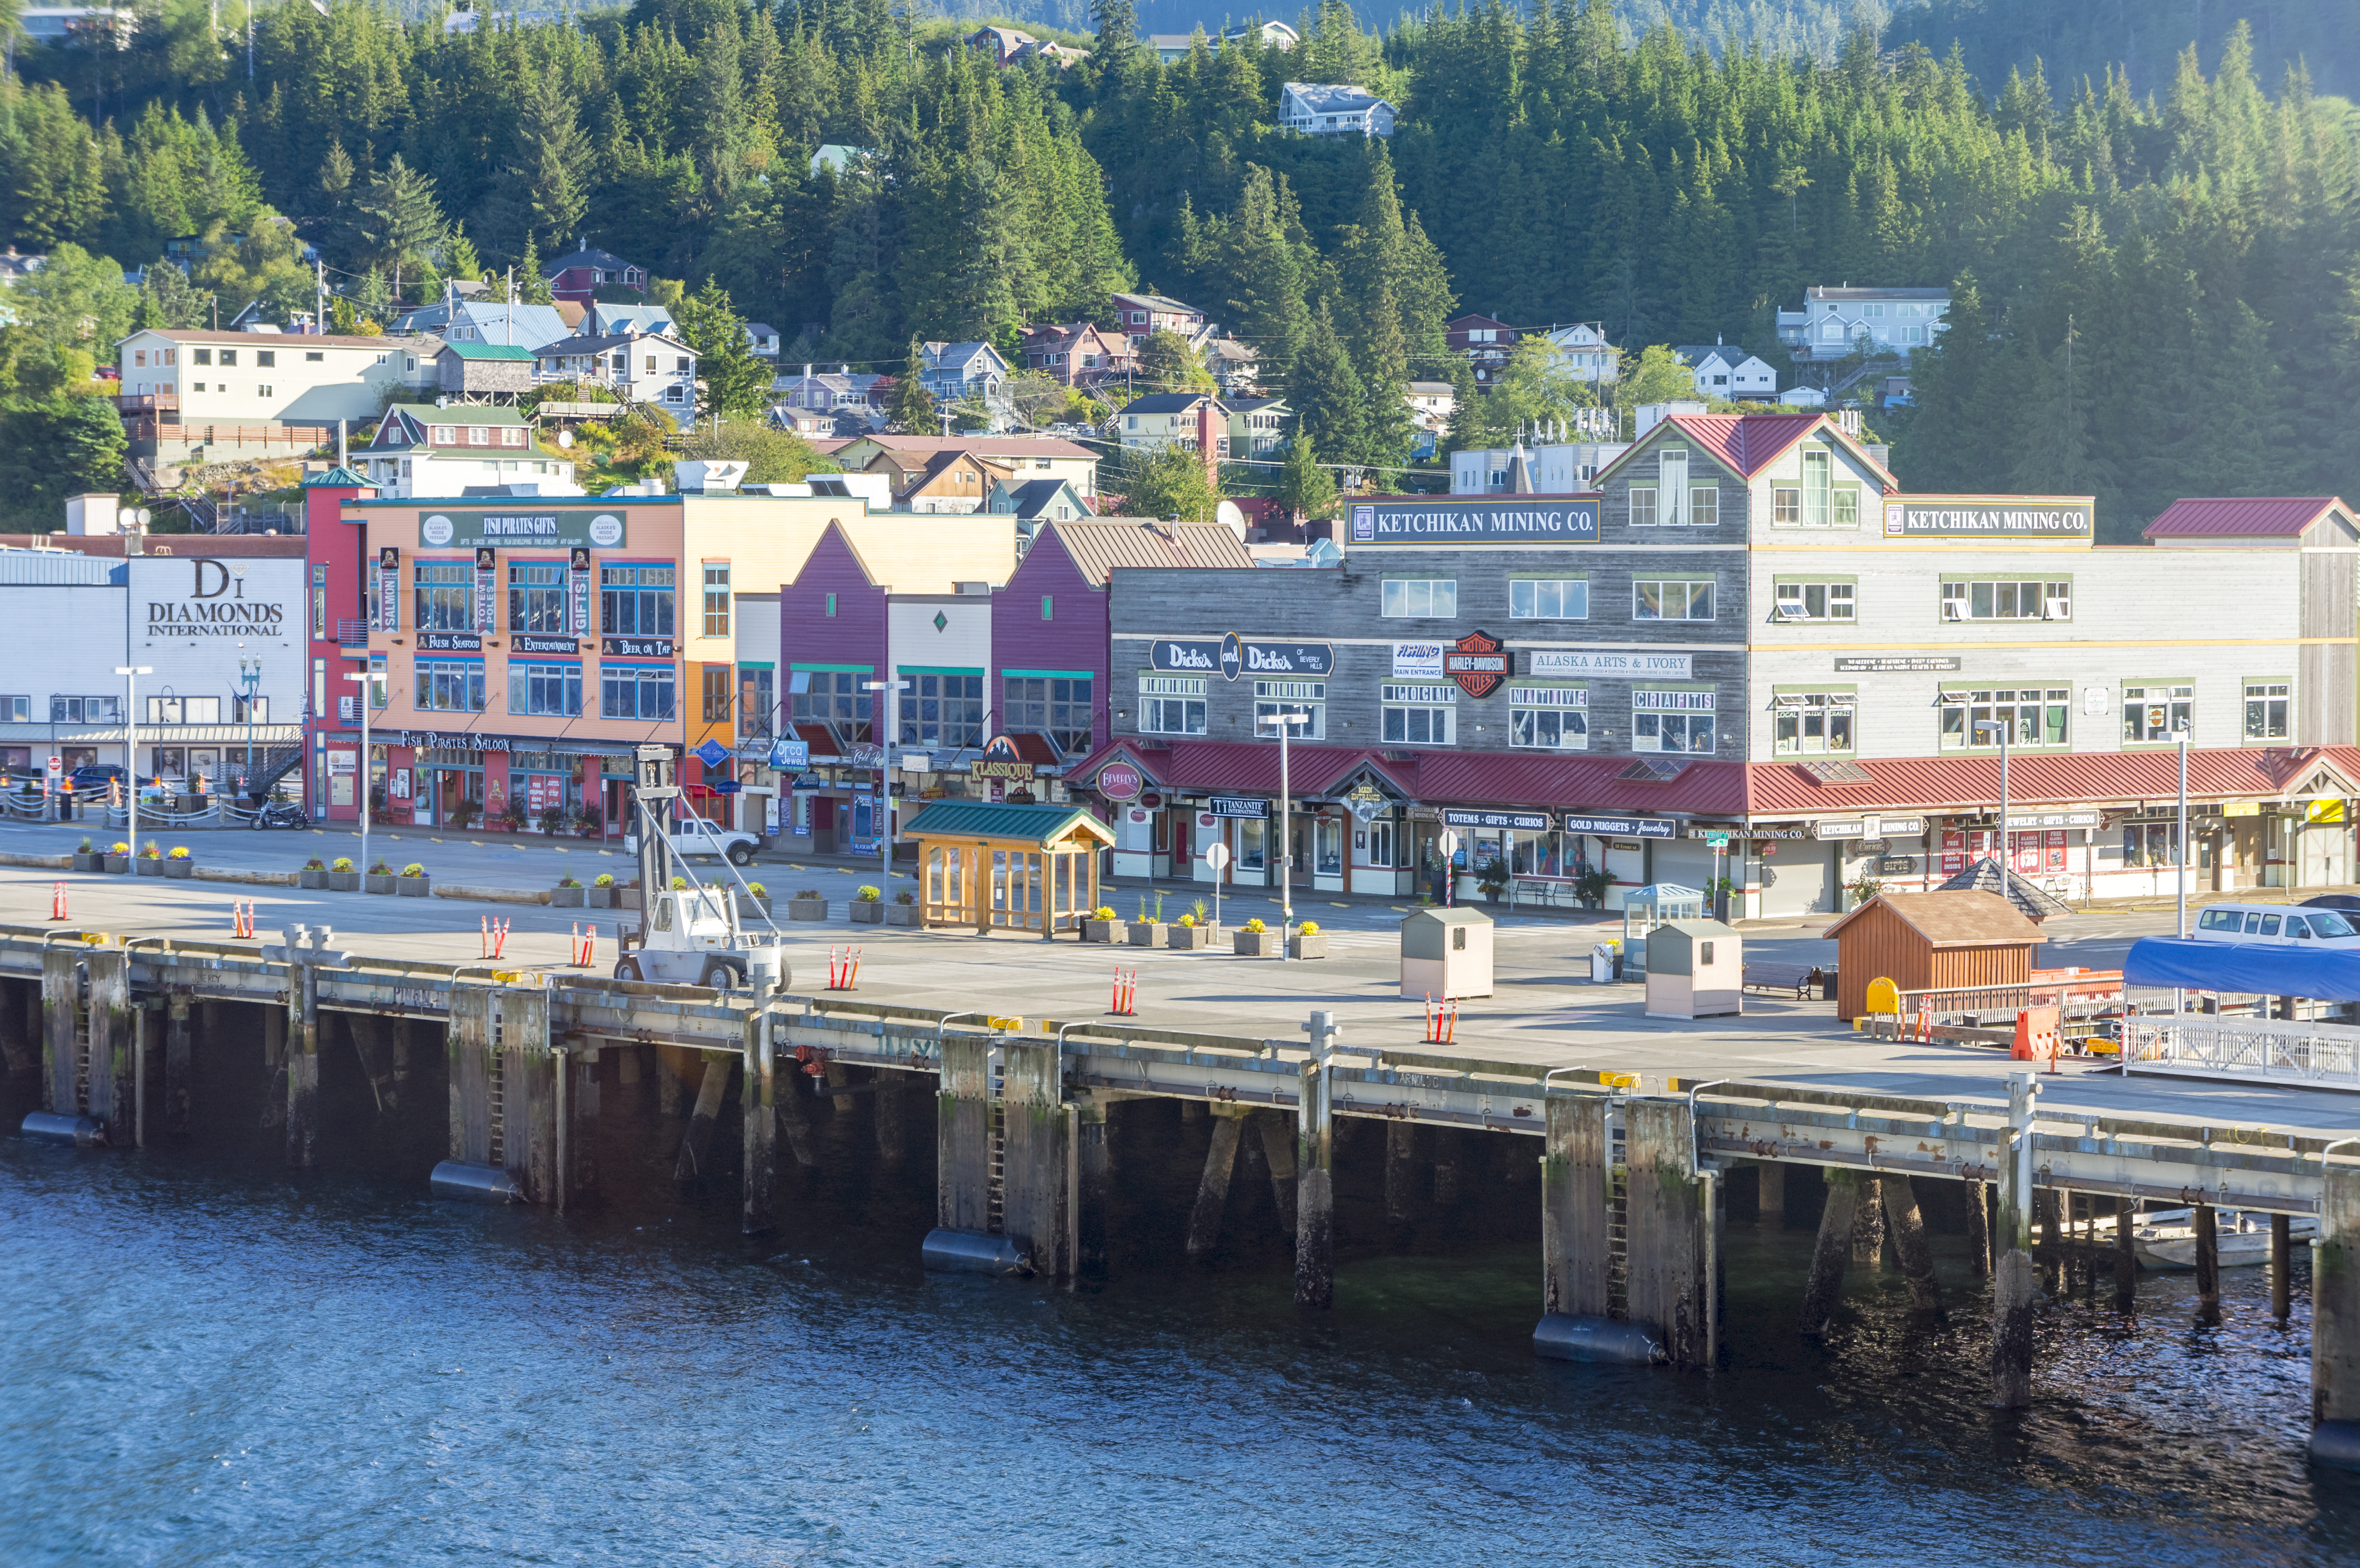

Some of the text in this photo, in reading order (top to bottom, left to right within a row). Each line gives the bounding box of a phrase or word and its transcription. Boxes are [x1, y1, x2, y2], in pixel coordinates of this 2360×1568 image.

[483, 517, 556, 534] FISH PIRATES GIFTS
[1378, 512, 1593, 532] KETCHIKAN MINING CO.
[1907, 511, 1999, 529] KETCHIKAN
[2004, 512, 2060, 529] MINING
[2062, 512, 2088, 529] CO.
[385, 581, 395, 626] SALMON
[575, 583, 587, 629] GIFTS
[148, 603, 283, 623] DIAMONDS
[148, 625, 282, 636] INTERNATIONAL
[1397, 644, 1440, 658] FISHING
[1462, 637, 1491, 652] MOTOR
[1169, 644, 1293, 670] Dicker and Dicker
[1449, 657, 1504, 671] HARLEY-DAVIDSON
[1536, 655, 1686, 669] ALASKA ARTS & IVORY
[1269, 683, 1311, 698] FURS
[1462, 674, 1490, 692] CYCLES
[1398, 687, 1454, 701] LOCAL
[1514, 689, 1585, 705] NATIVE
[1637, 693, 1712, 708] CRAFTS
[401, 731, 511, 752] FISH PIRATES SALOON
[971, 761, 1033, 781] KLASSIQUE
[1103, 773, 1137, 786] BEVERLY'S
[1351, 793, 1380, 801] ENTRANCE
[1449, 813, 1543, 827] TOTEMS GIFTS CURIOS
[2043, 816, 2064, 825] GIFTS
[2069, 814, 2095, 824] CURIOS
[1571, 820, 1670, 836] GOLD NUGGETS Jewelry
[1821, 821, 1919, 834] KETCHIKAN MINING CO.
[1859, 842, 1884, 852] Curios
[1884, 860, 1908, 871] GIFTS
[2020, 854, 2038, 868] $20
